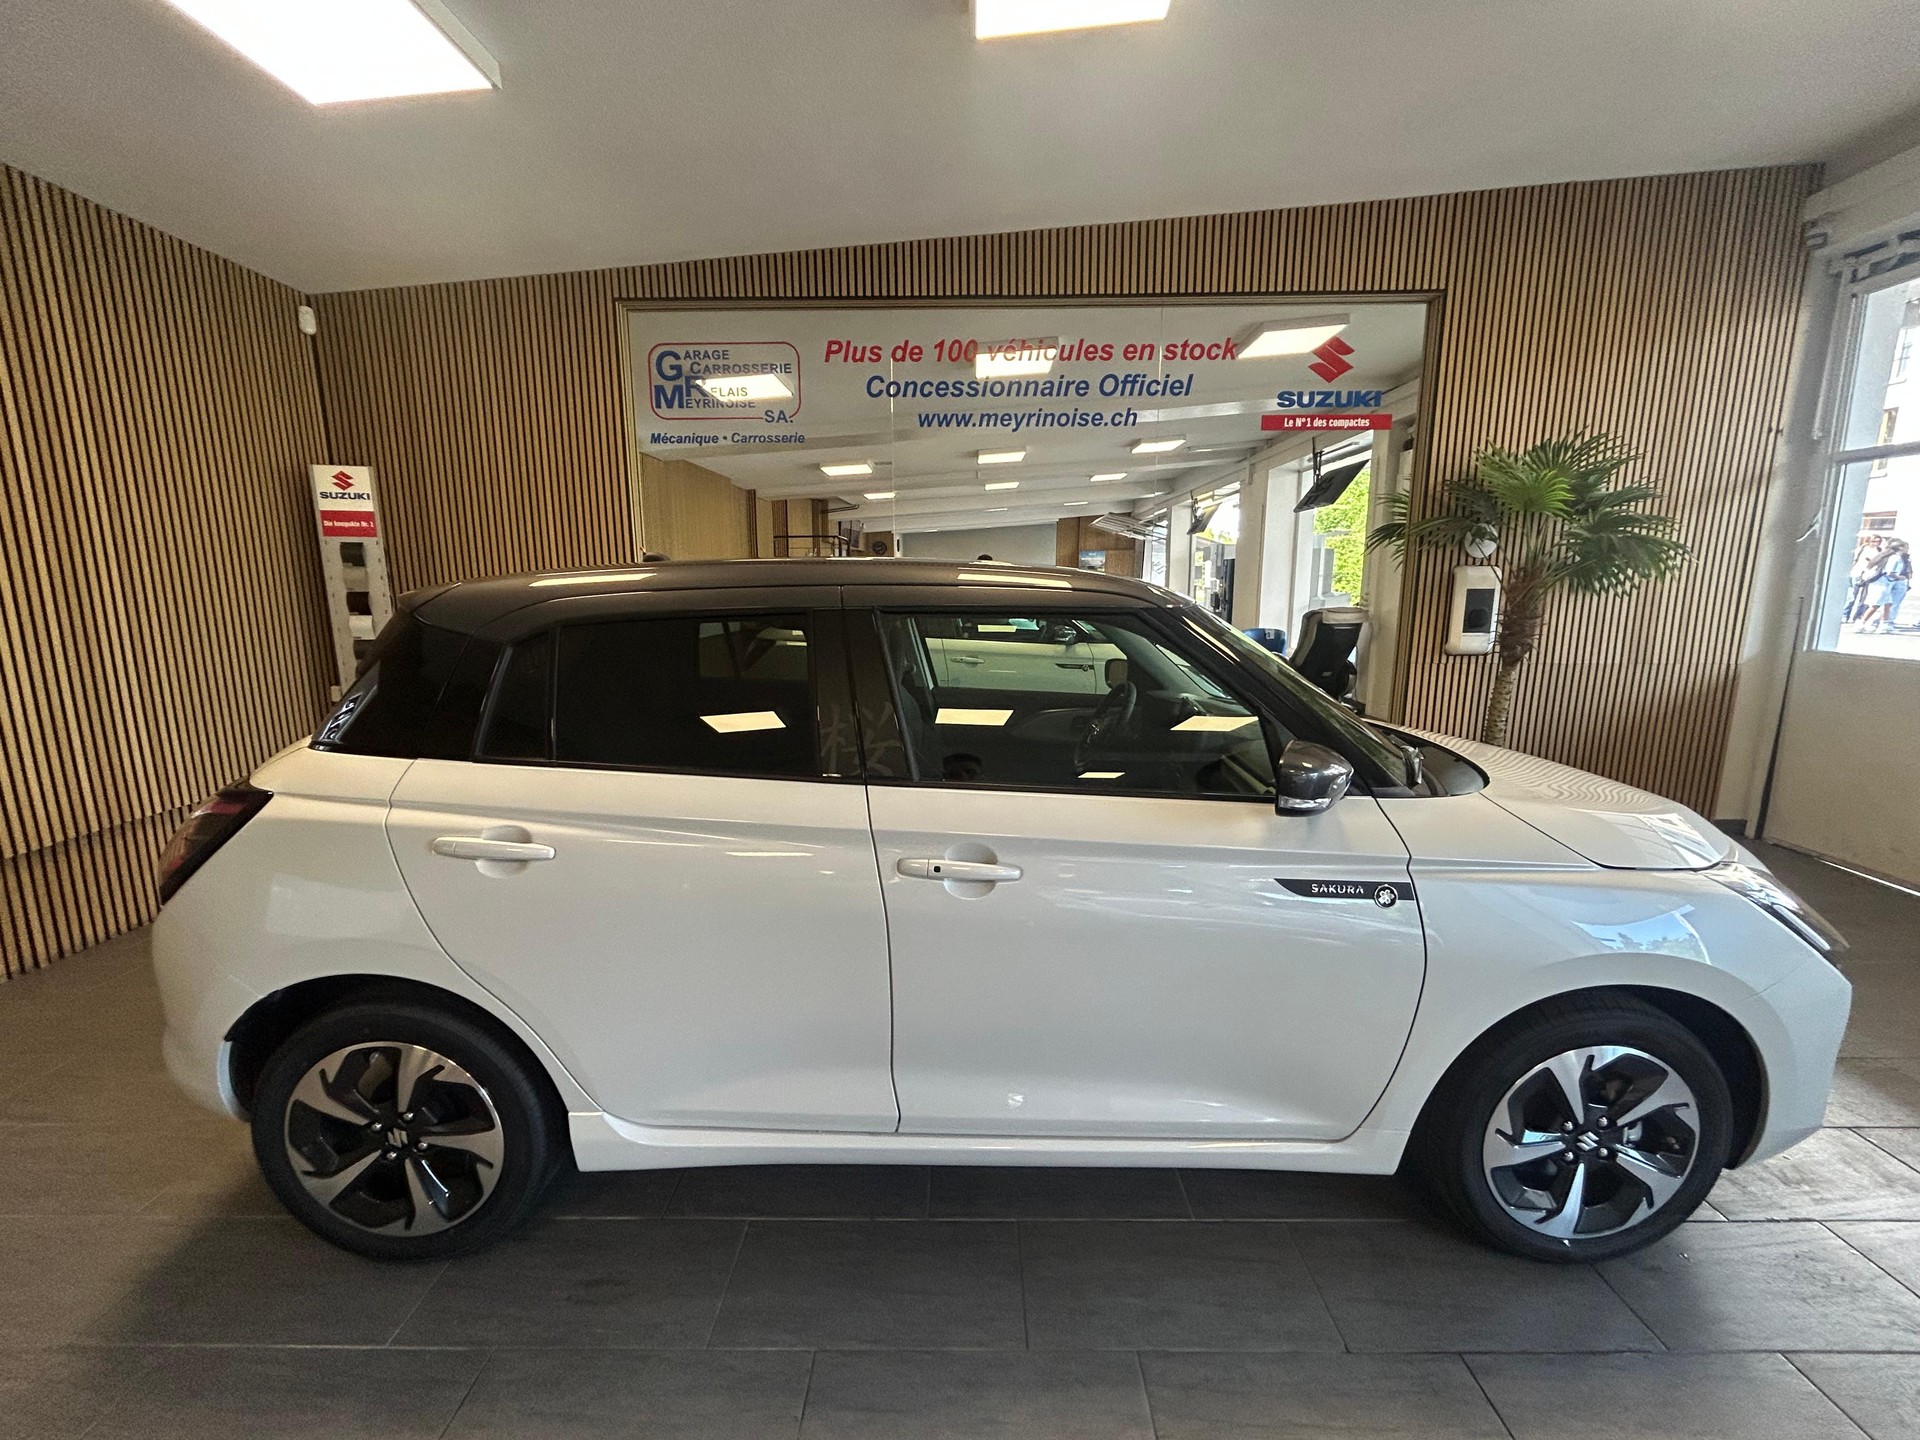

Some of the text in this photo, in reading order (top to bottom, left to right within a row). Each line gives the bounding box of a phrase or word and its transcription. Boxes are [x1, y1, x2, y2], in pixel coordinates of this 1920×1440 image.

[824, 337, 1237, 363] Plus de 100 véhicules en stock
[690, 361, 792, 375] CARROSSERIE
[866, 373, 1194, 398] Concessionnaire Officiel
[1276, 390, 1383, 408] SUZUKI
[918, 407, 1138, 433] www.meyrinoise.ch
[1284, 417, 1294, 427] Le
[1313, 417, 1328, 427] des
[1329, 417, 1370, 428] compactes
[650, 432, 805, 446] Mécanique Carrosserie
[319, 491, 371, 500] SUZUKI
[1311, 883, 1364, 894] SAKURA
